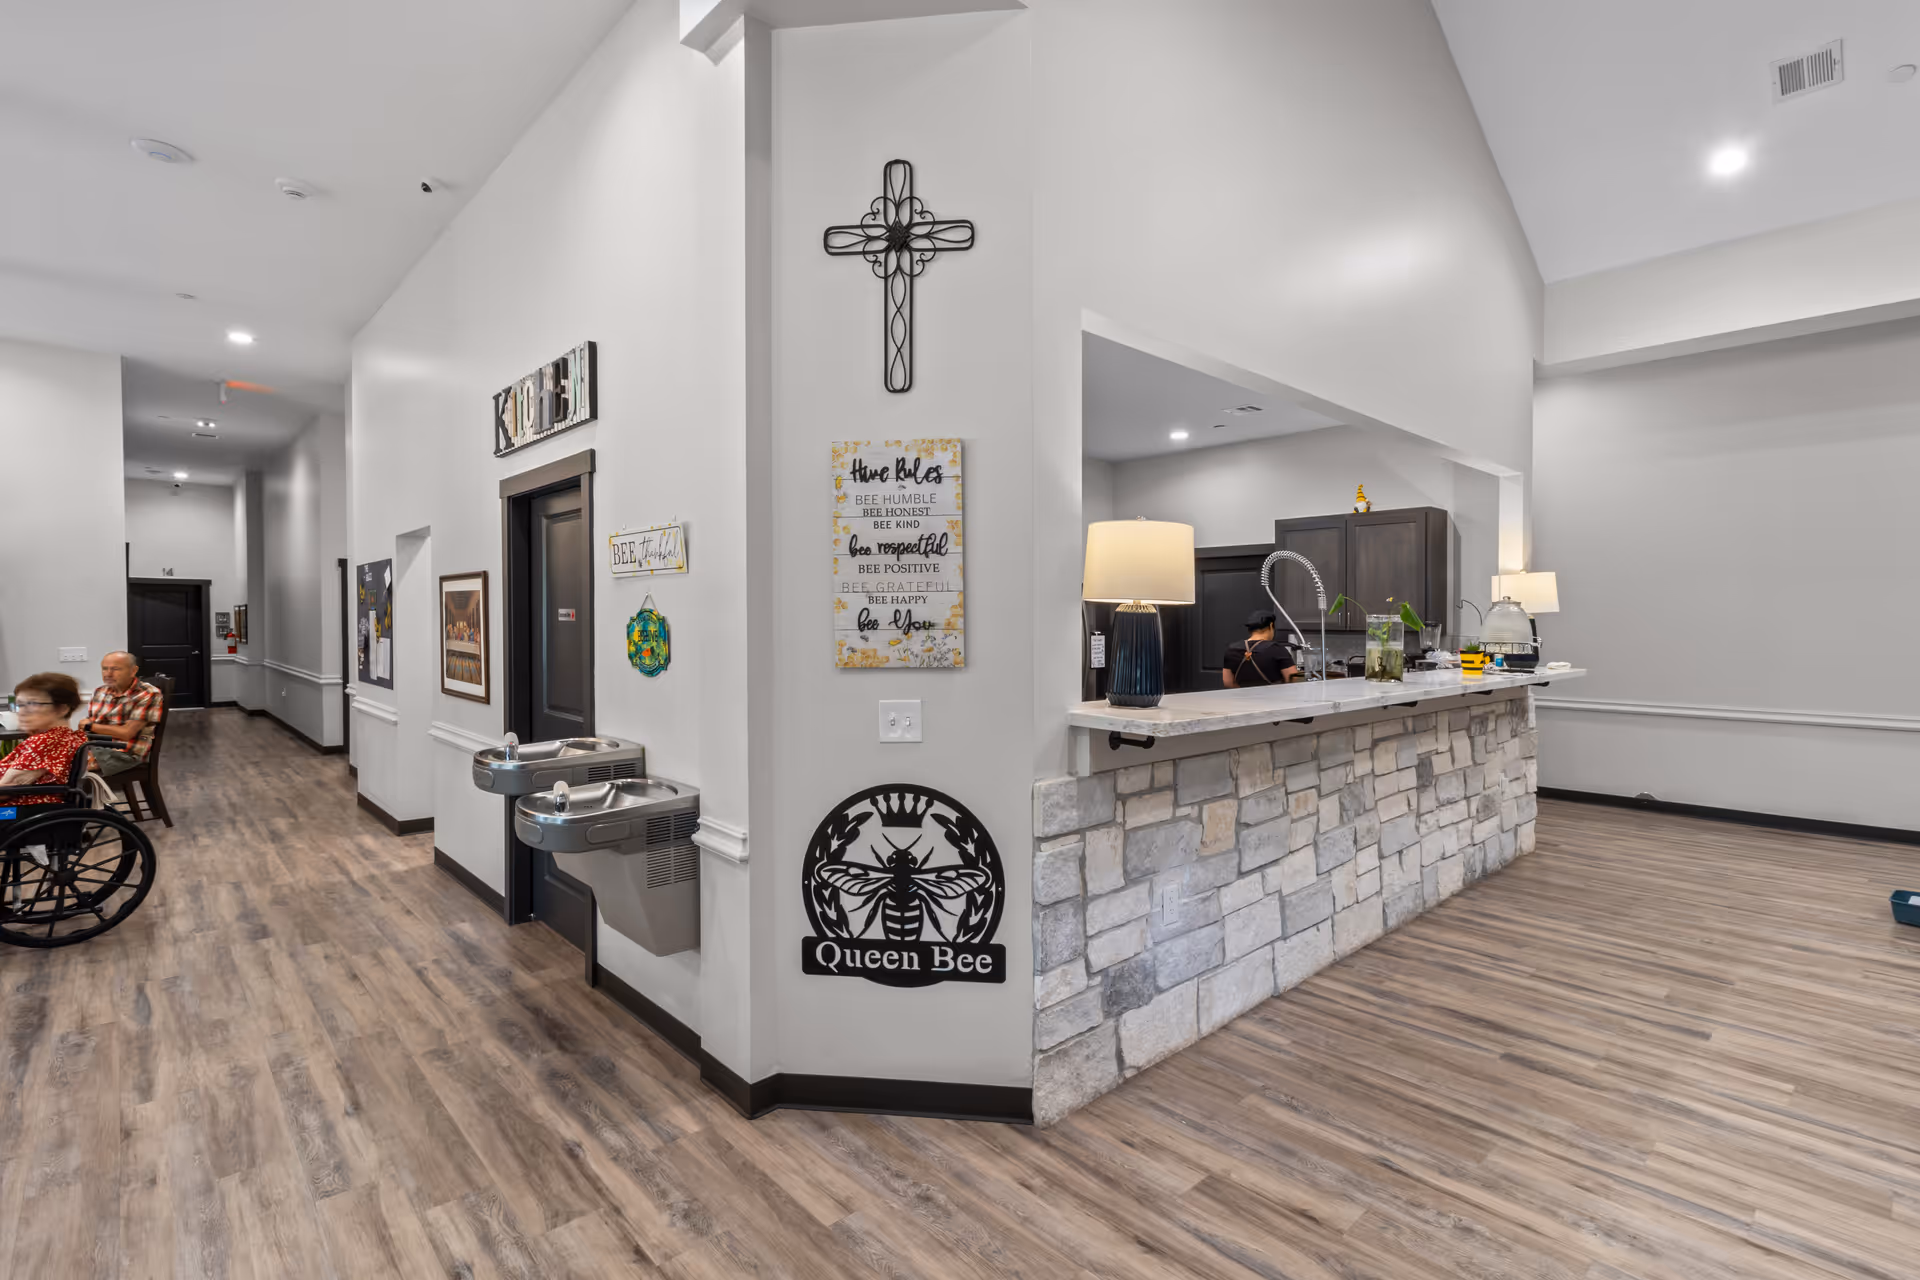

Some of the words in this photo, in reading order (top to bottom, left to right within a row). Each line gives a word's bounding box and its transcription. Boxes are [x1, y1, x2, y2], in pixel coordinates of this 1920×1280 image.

[850, 458, 889, 483] Hive
[895, 457, 943, 485] Rules
[855, 494, 879, 505] BEE
[883, 493, 937, 505] HUMBLE
[862, 508, 882, 517] BEE
[885, 507, 931, 517] HONEST
[873, 520, 892, 529] BEE
[895, 520, 920, 529] KIND
[612, 541, 637, 565] BEE
[849, 534, 872, 558] bee
[877, 532, 949, 561] respectful
[858, 564, 881, 574] BEE
[884, 563, 940, 574] POSITIVE
[841, 582, 868, 593] BEE
[876, 580, 952, 593] GRATEFUL
[867, 596, 887, 605] BEE
[890, 595, 928, 605] HAPPY
[857, 607, 880, 632] bee
[888, 609, 936, 635] You
[815, 941, 921, 974] Queen
[930, 945, 993, 974] Bee
